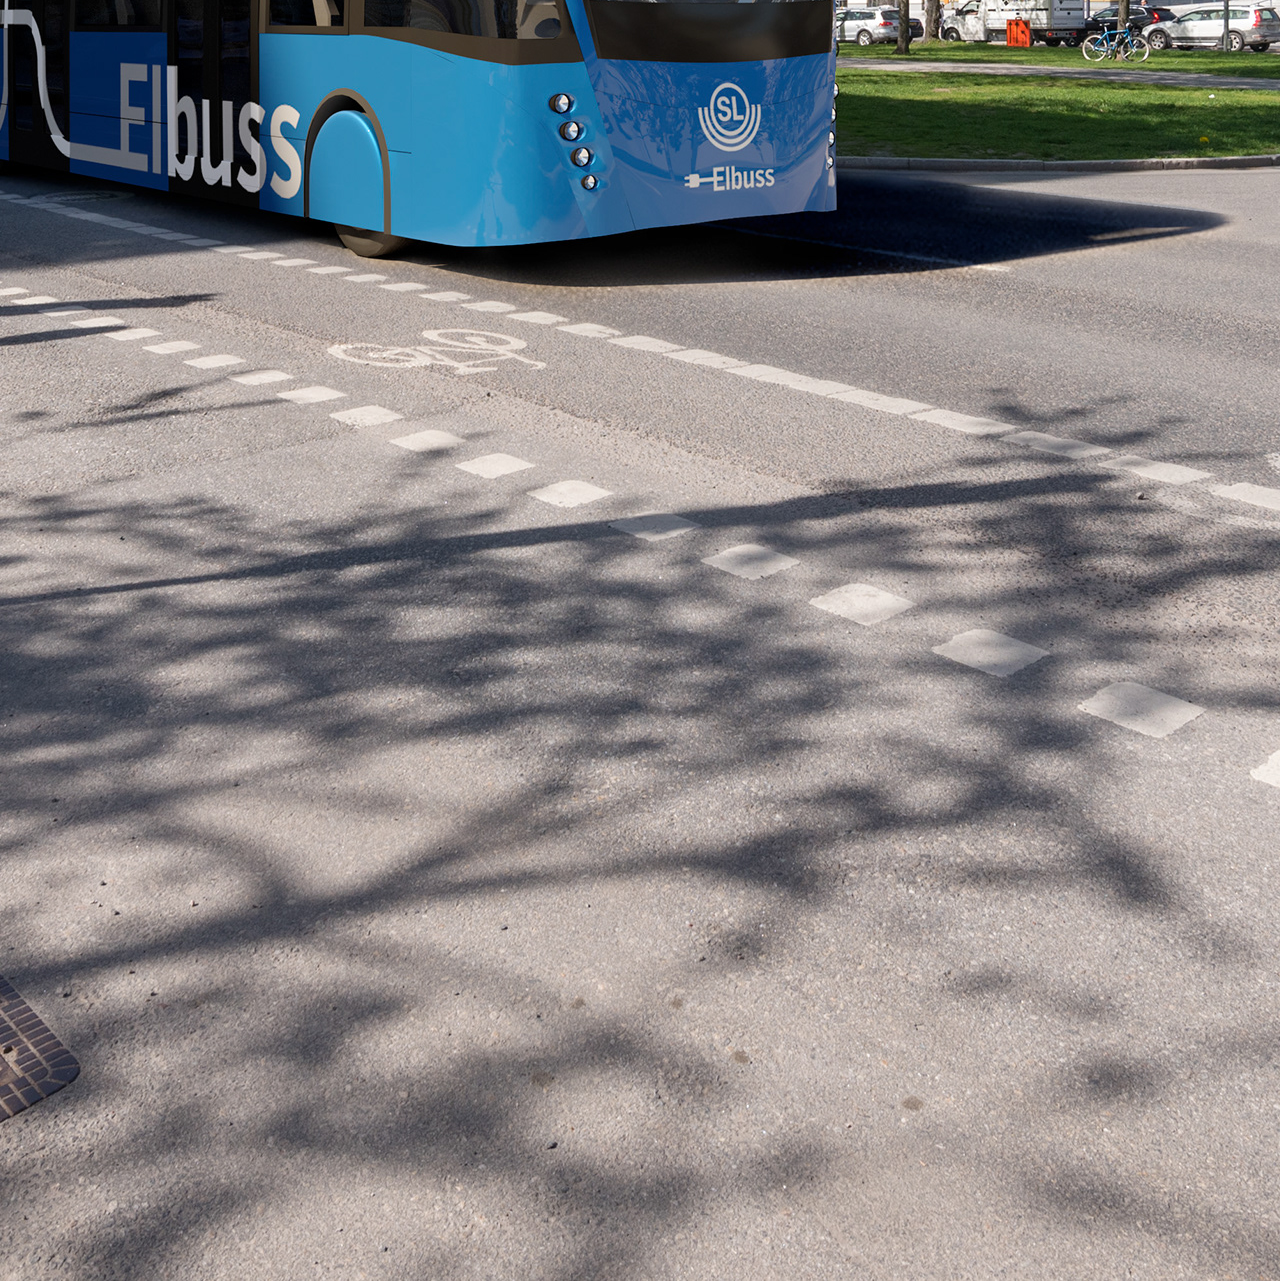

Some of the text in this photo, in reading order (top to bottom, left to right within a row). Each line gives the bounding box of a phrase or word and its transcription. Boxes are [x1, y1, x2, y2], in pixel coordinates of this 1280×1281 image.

[716, 96, 745, 122] SL
[120, 62, 301, 199] Elbuss
[713, 164, 776, 192] Elbuss
